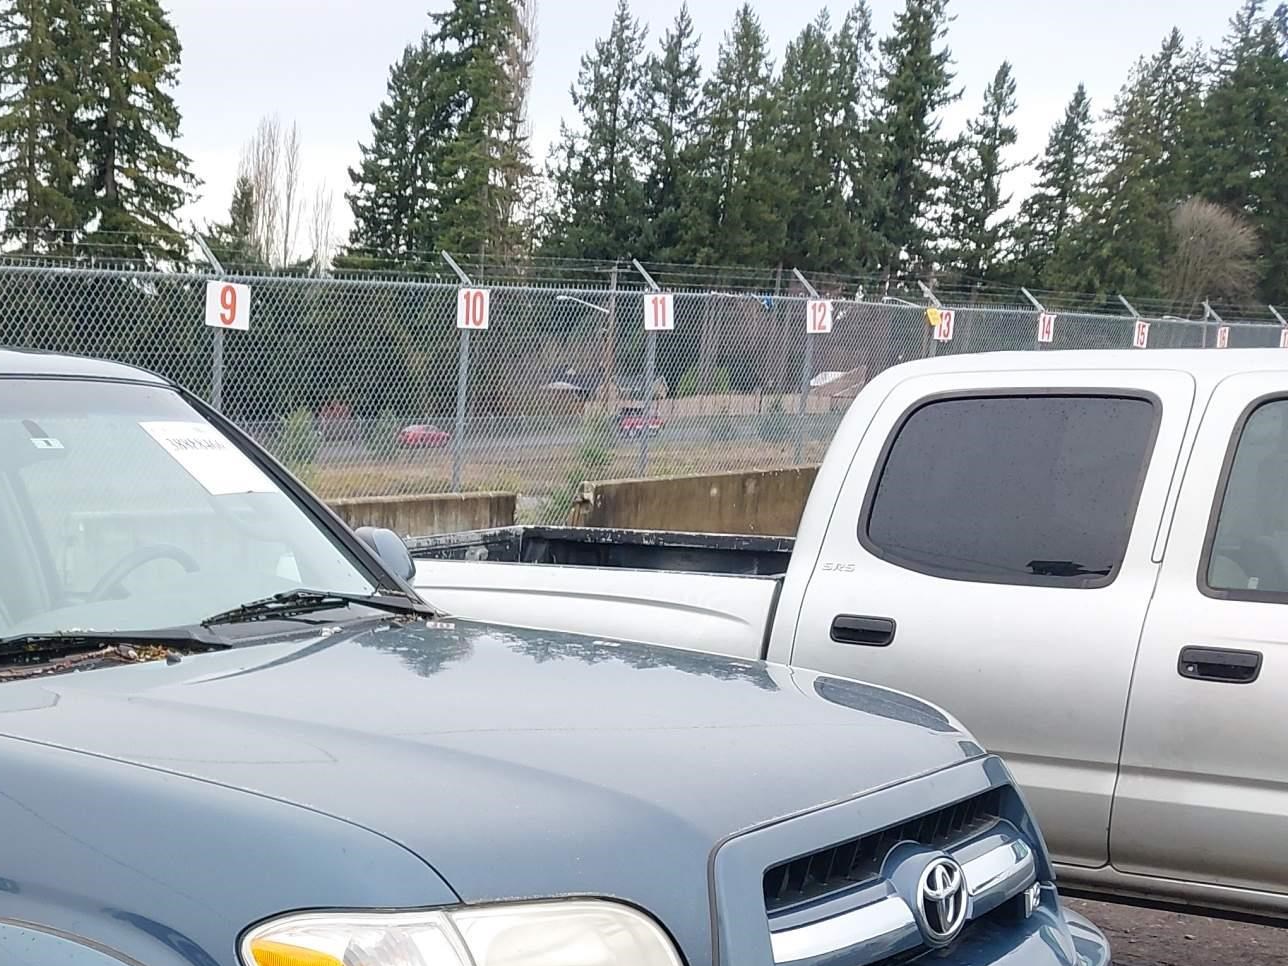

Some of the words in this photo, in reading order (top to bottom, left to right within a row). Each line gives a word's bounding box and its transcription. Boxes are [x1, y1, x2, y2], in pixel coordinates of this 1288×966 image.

[219, 285, 237, 325] 9
[464, 290, 485, 327] 10
[651, 296, 666, 328] 11
[811, 302, 828, 331] 12
[938, 311, 952, 338] 13
[1042, 316, 1052, 340] 14
[1136, 323, 1146, 346] 15
[822, 562, 856, 573] SRS
